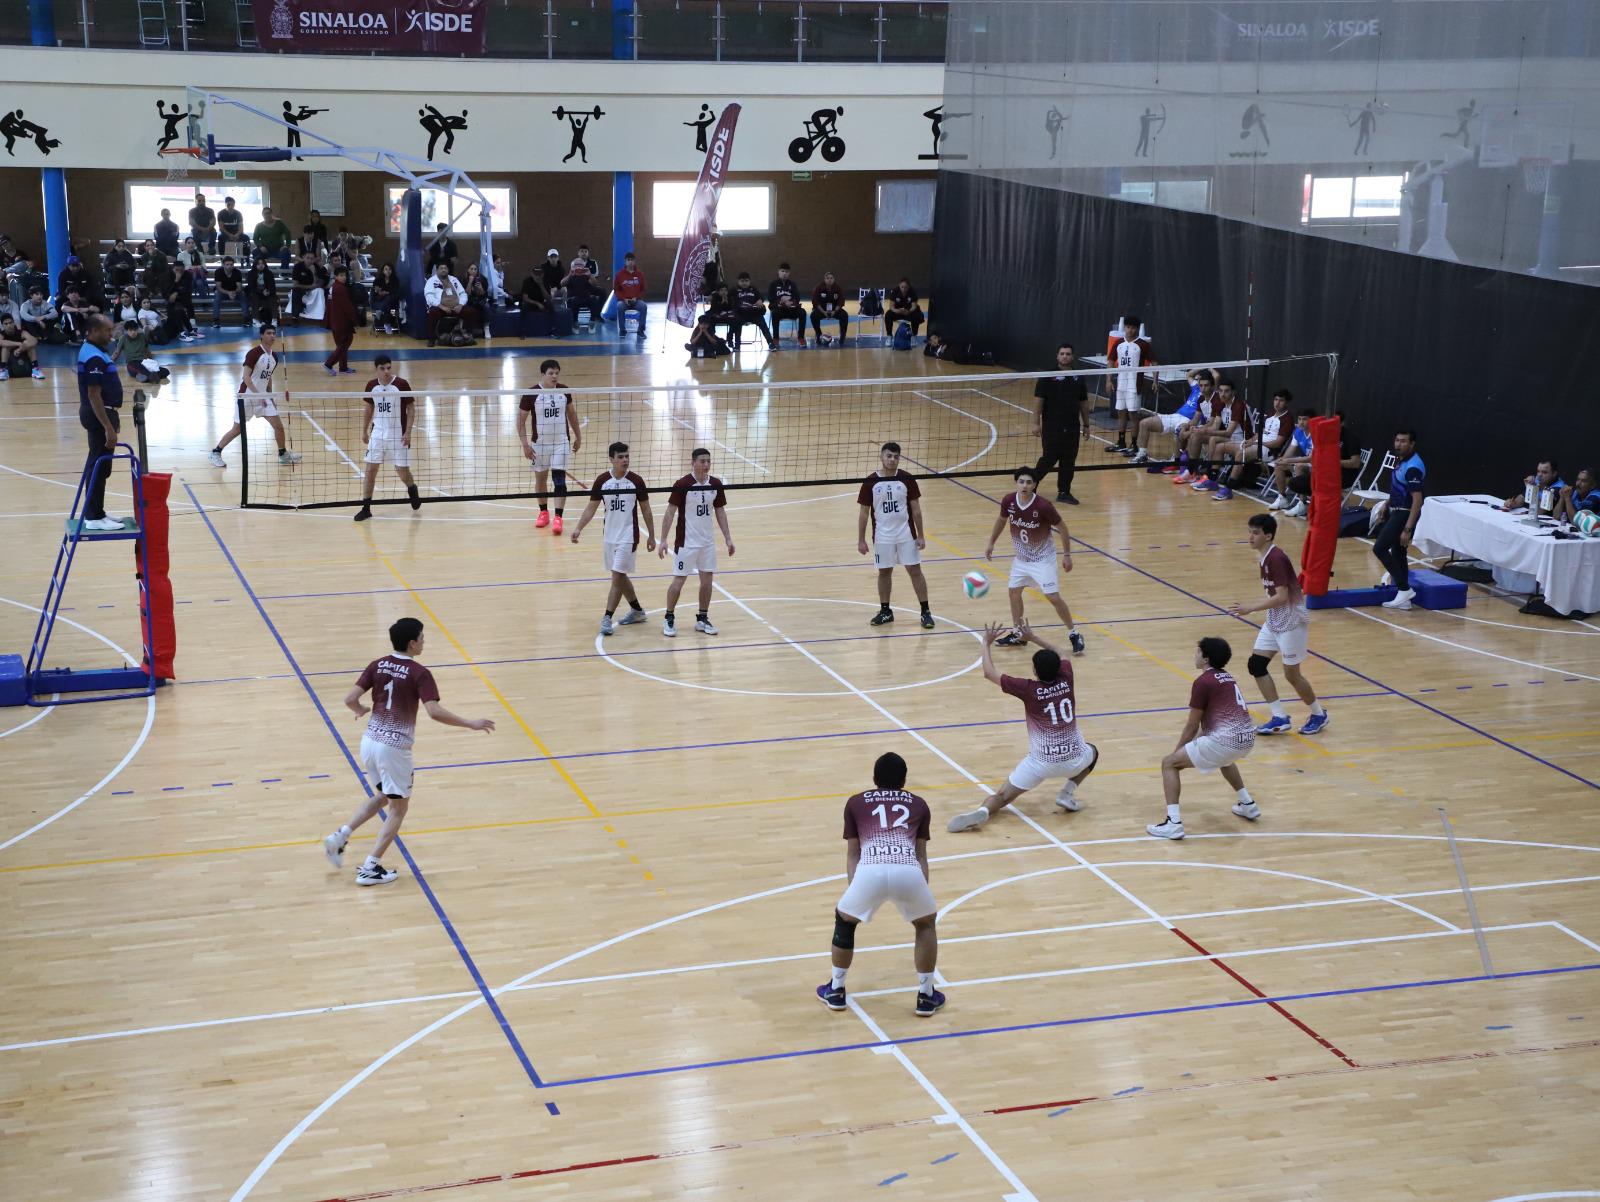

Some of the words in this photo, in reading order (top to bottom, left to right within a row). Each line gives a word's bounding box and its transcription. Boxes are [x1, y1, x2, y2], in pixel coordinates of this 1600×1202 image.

[300, 11, 388, 29] SINALOA
[425, 12, 473, 32] ISDE
[1339, 19, 1379, 36] ISDE
[1238, 23, 1307, 37] SINALOA
[709, 127, 730, 179] ISDE
[887, 491, 893, 501] 11
[1020, 529, 1029, 544] 6
[678, 561, 684, 570] 8
[377, 660, 410, 675] CAPITAL
[383, 680, 394, 710] 1
[1036, 681, 1069, 696] CAPITAL
[1234, 684, 1248, 710] 4
[1043, 698, 1074, 725] 10
[863, 790, 914, 799] CAPITAL
[871, 804, 910, 829] 12
